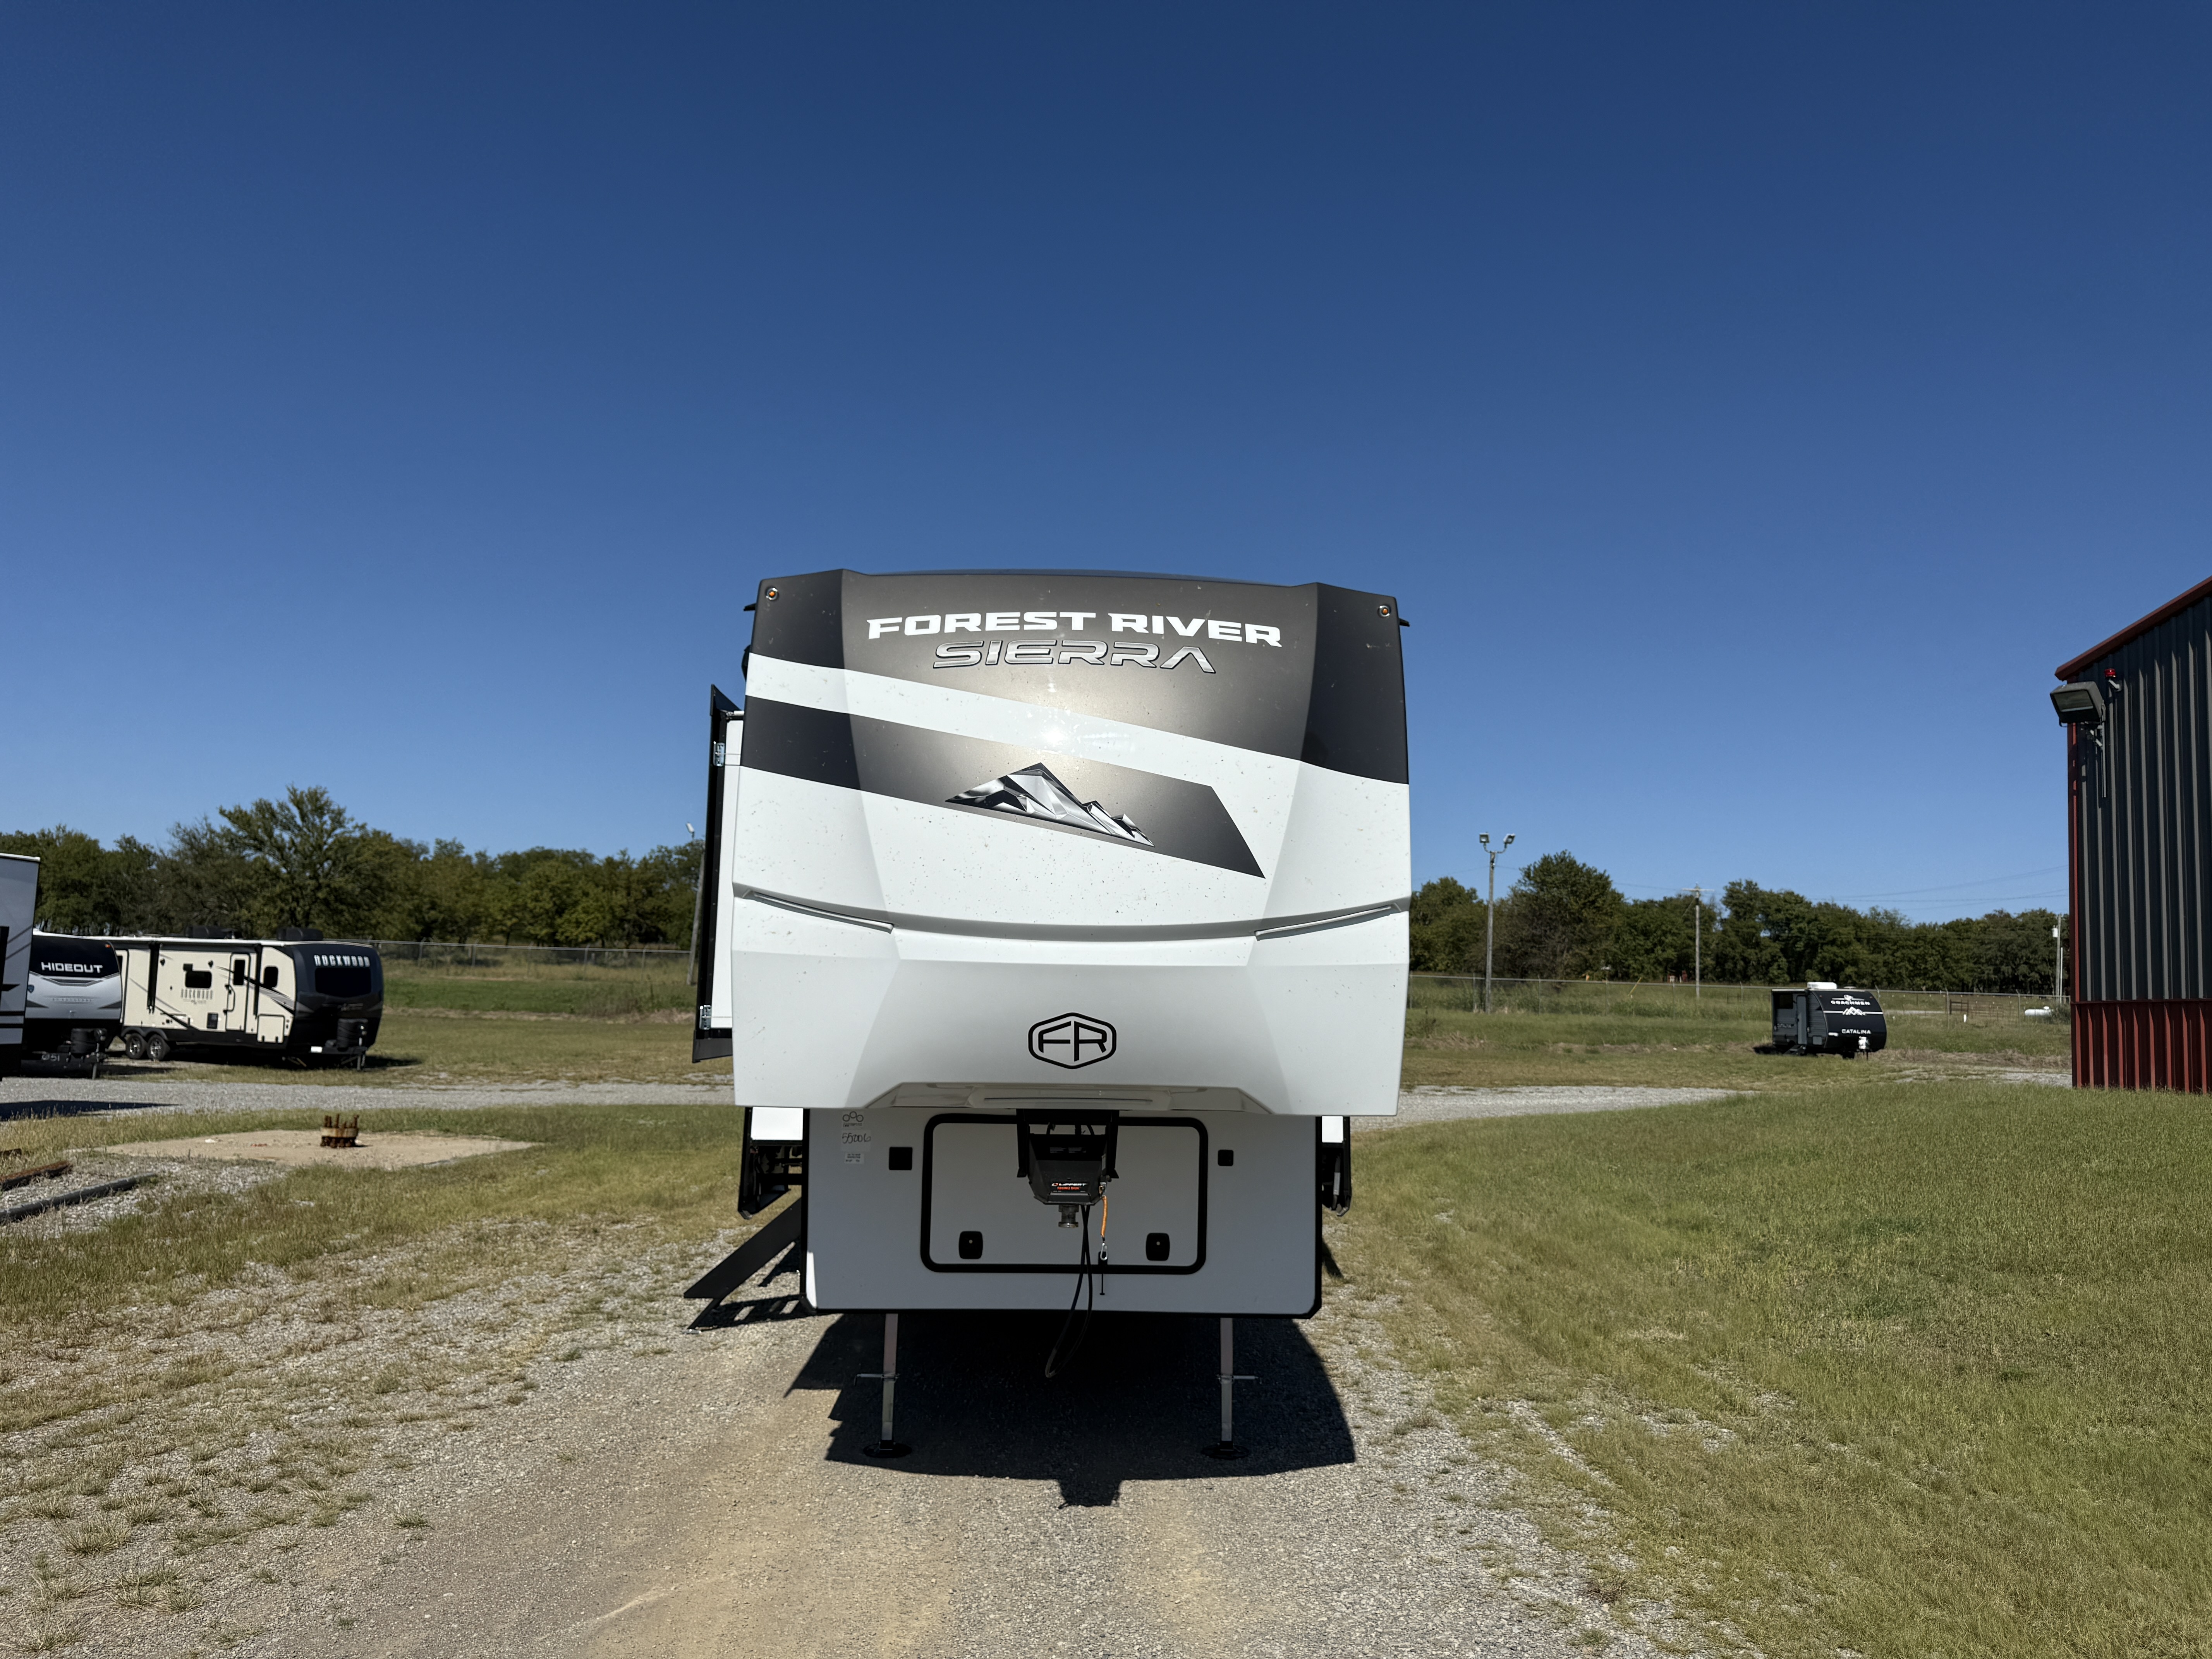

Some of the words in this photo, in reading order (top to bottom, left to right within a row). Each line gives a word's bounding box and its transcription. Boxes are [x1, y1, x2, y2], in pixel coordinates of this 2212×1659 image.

[867, 611, 1096, 639] FOREST
[1108, 613, 1283, 647] RIVER
[933, 639, 1216, 674] SIERRA
[41, 962, 103, 974] HIDEOUT
[314, 955, 370, 967] ROCKWOOD
[1038, 1020, 1107, 1062] FR
